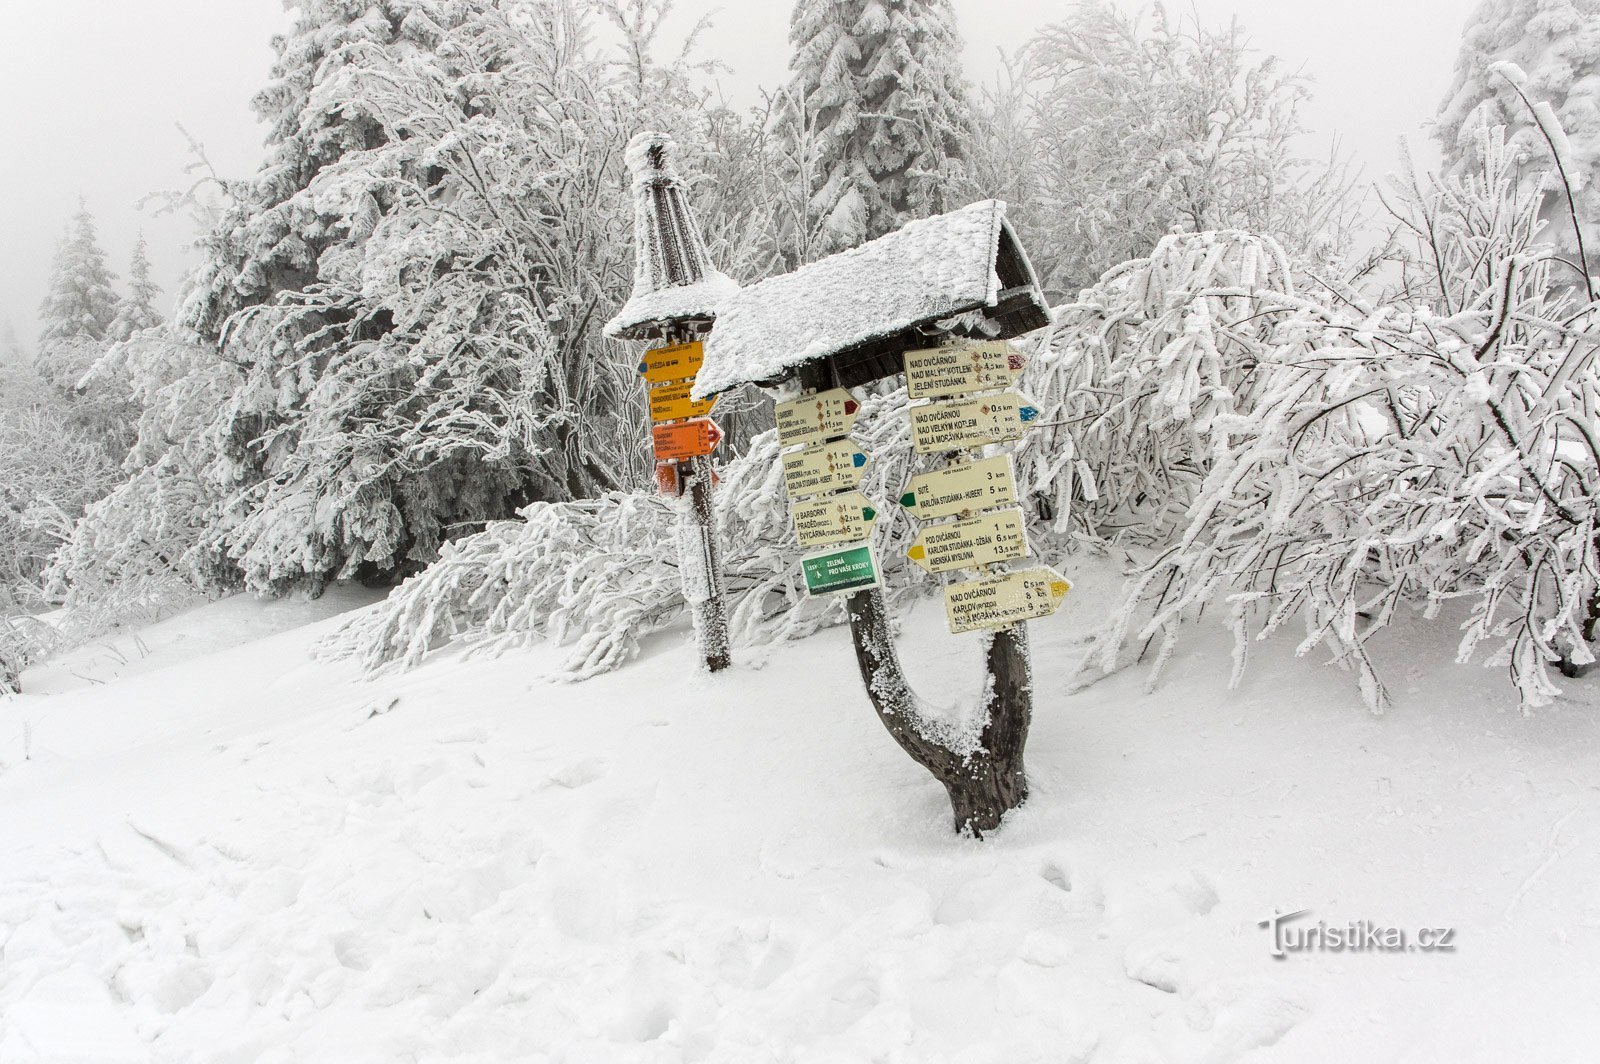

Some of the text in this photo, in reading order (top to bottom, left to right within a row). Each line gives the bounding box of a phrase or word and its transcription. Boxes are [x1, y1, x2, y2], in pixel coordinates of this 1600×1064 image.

[910, 360, 922, 368] NAD
[924, 355, 956, 366] OVČÁRNOU
[911, 371, 924, 380] NAD
[914, 378, 933, 391] JELENÍ
[935, 376, 967, 388] STUDÁNKA
[916, 414, 928, 424] NAD
[929, 409, 960, 422] OVČÁRNOU
[991, 404, 1002, 412] 0,5
[917, 426, 930, 434] NAD
[930, 420, 954, 433] VELKÝM
[954, 418, 977, 430] KOTLEM
[919, 435, 935, 446] MALÁ
[936, 431, 964, 443] MORÁVKA
[918, 484, 929, 495] SUTĚ
[987, 472, 992, 480] 3
[920, 497, 940, 508] KARLOVA
[940, 492, 963, 505] STUDÁNKA
[966, 489, 983, 499] HUBERT
[990, 486, 995, 494] 5
[800, 508, 827, 519] BARBORKY
[936, 530, 961, 542] OVČÁRNOU
[928, 545, 949, 555] KARLOVA
[949, 540, 973, 552] STUDÁNKA
[976, 536, 992, 546] DŽBÁN
[996, 534, 1007, 542] 6,5
[827, 557, 845, 567] ZELENÁ
[930, 554, 951, 566] ANENSKÁ
[951, 551, 974, 562] MYSLIVNA
[993, 546, 1009, 554] 13,5
[840, 564, 852, 573] VAŠE
[852, 562, 869, 570] KROKY
[950, 594, 963, 603] NAD
[964, 587, 996, 600] OVČÁRNOU
